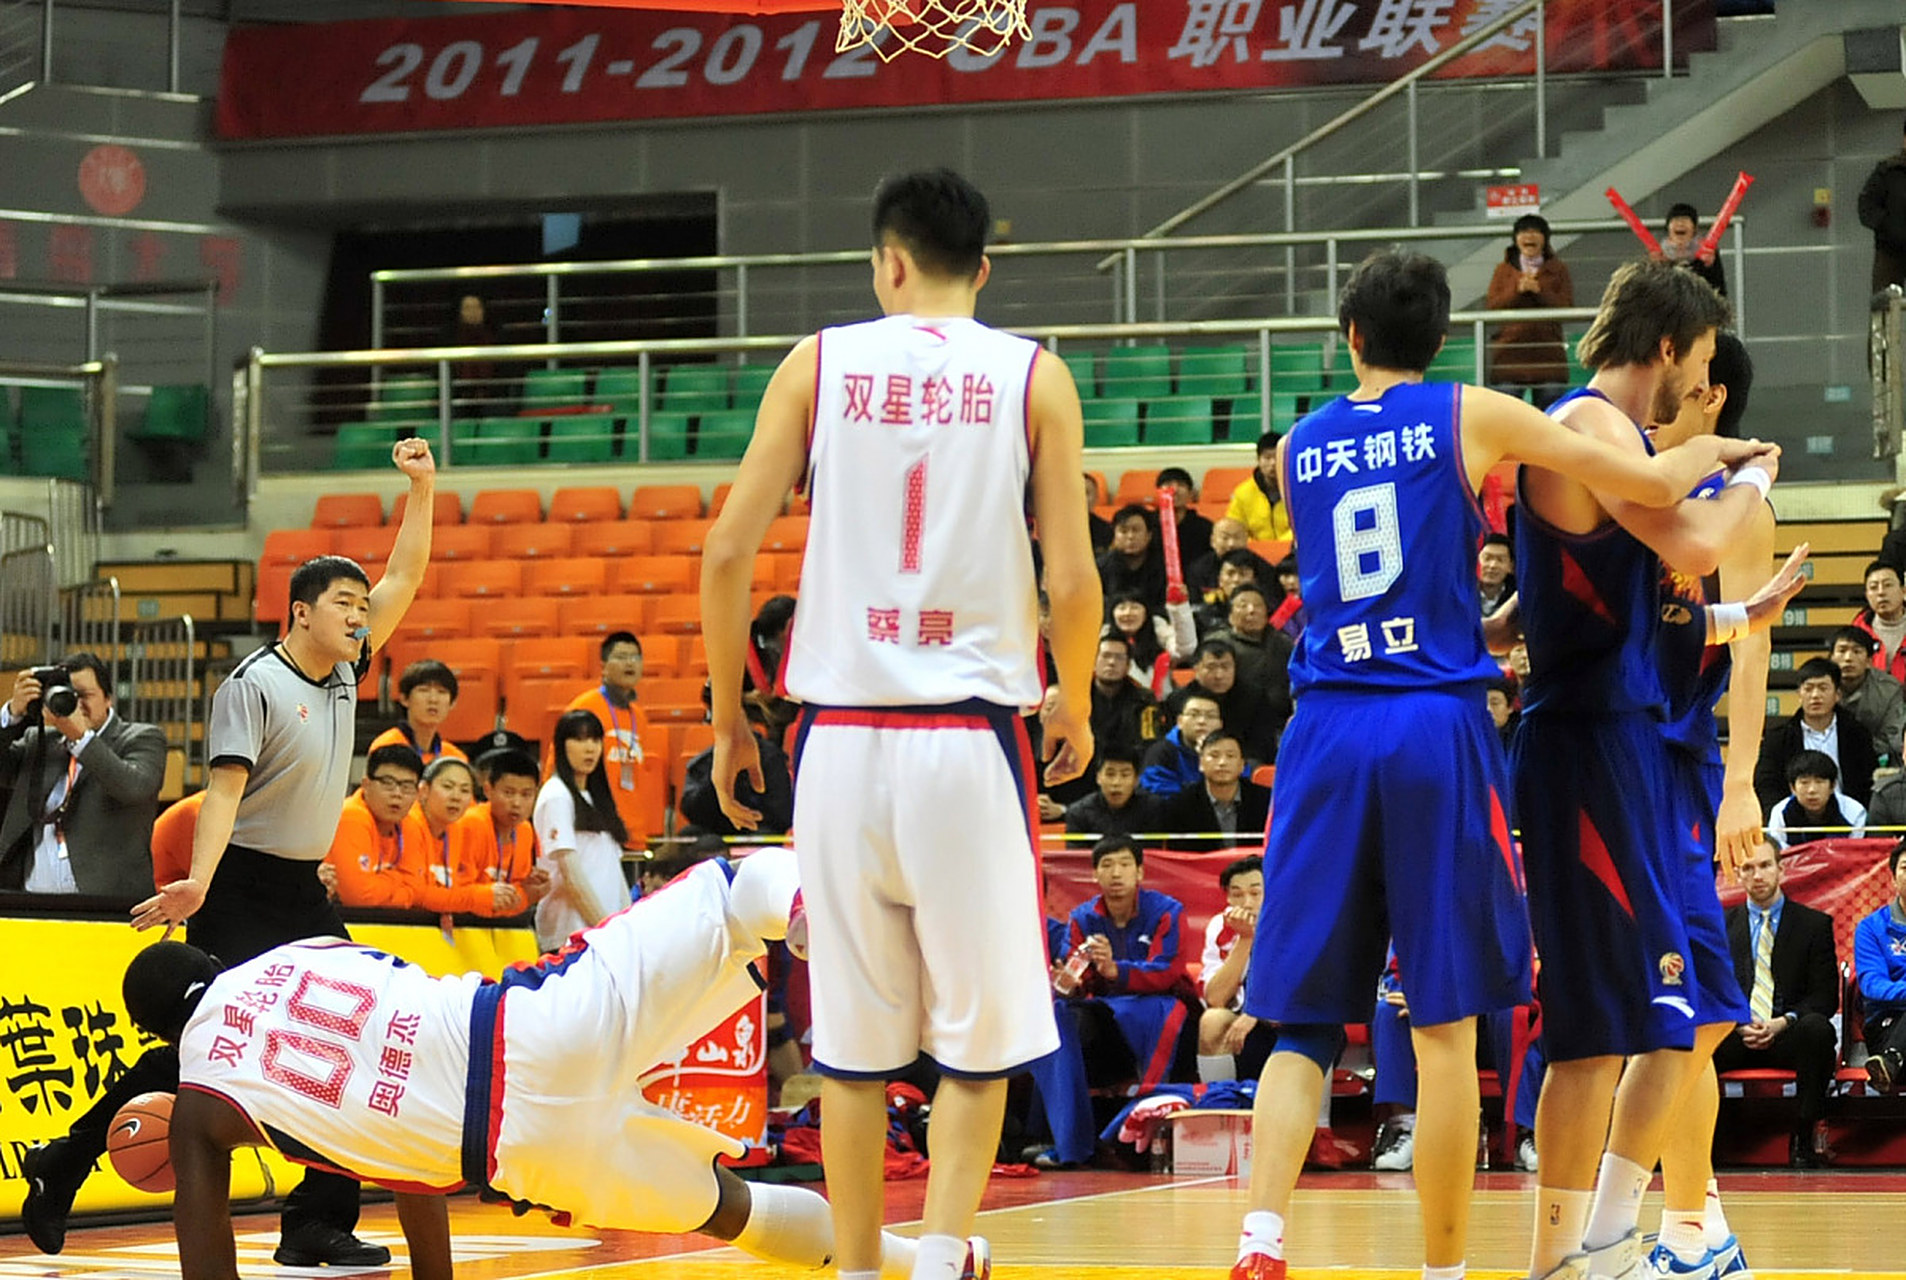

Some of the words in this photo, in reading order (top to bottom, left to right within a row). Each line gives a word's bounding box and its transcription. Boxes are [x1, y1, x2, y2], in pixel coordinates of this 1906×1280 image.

[359, 18, 890, 102] 2011-2012
[946, 3, 1138, 72] CBA
[1167, 0, 1542, 68] 职业联赛
[842, 373, 995, 426] 双星轮胎
[1296, 421, 1437, 484] 中天钢铁
[898, 451, 931, 575] 1
[1332, 480, 1404, 603] 8
[1336, 616, 1420, 664] 易立
[208, 962, 296, 1068] 双星轮胎
[259, 969, 379, 1110] 00
[368, 1009, 421, 1118] 奥德杰
